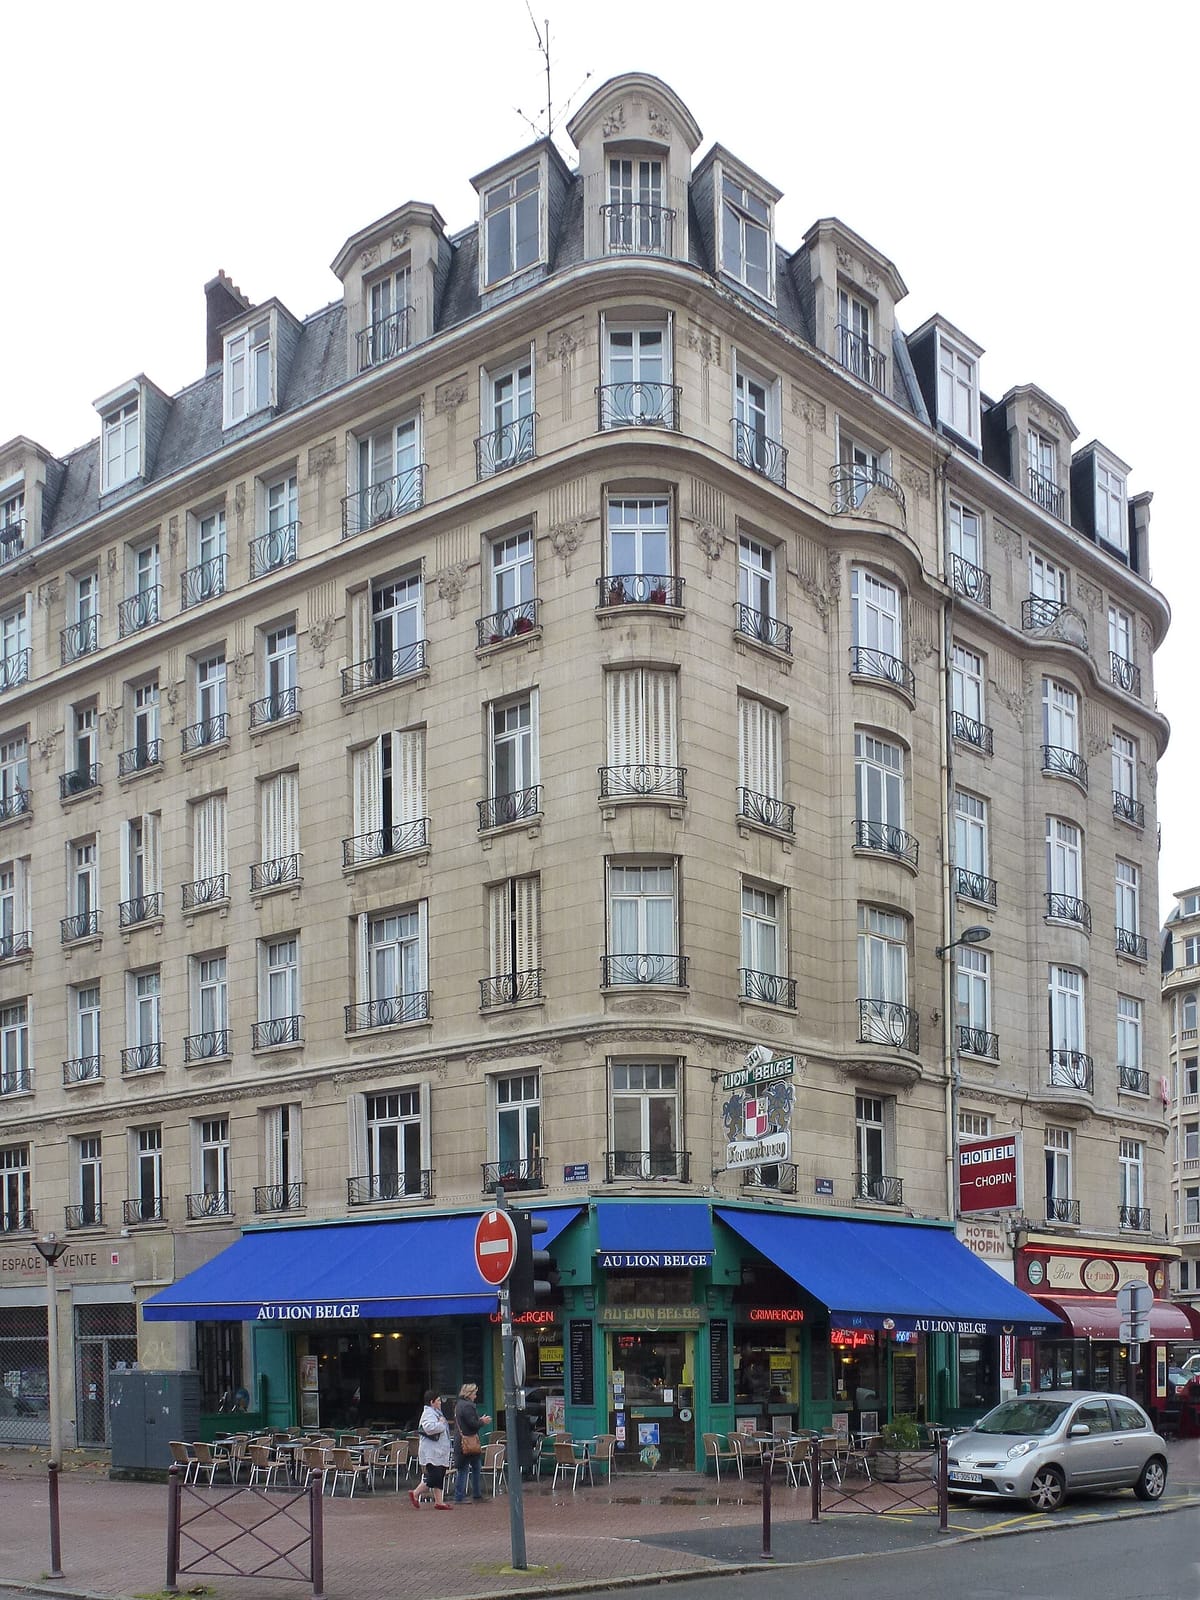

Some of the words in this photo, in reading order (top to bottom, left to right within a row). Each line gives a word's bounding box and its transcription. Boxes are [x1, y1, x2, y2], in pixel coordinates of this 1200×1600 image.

[724, 1070, 749, 1088] LION
[753, 1058, 792, 1081] BELGE
[961, 1145, 1014, 1165] HOTEL
[975, 1172, 1012, 1187] CHOPIN
[966, 1227, 999, 1239] HOTEL
[2, 1257, 41, 1270] ESPACE
[62, 1253, 97, 1267] VENTE
[603, 1255, 622, 1267] AU
[625, 1255, 660, 1266] LION
[663, 1255, 707, 1266] BELGE
[1053, 1264, 1074, 1280] Bar
[257, 1307, 275, 1320] AU
[278, 1305, 313, 1320] LION
[315, 1304, 360, 1319] BELGE
[750, 1309, 804, 1321] GRIMBERGEN
[915, 1320, 929, 1331] AU
[931, 1320, 956, 1332] LION
[958, 1321, 987, 1334] BELGE
